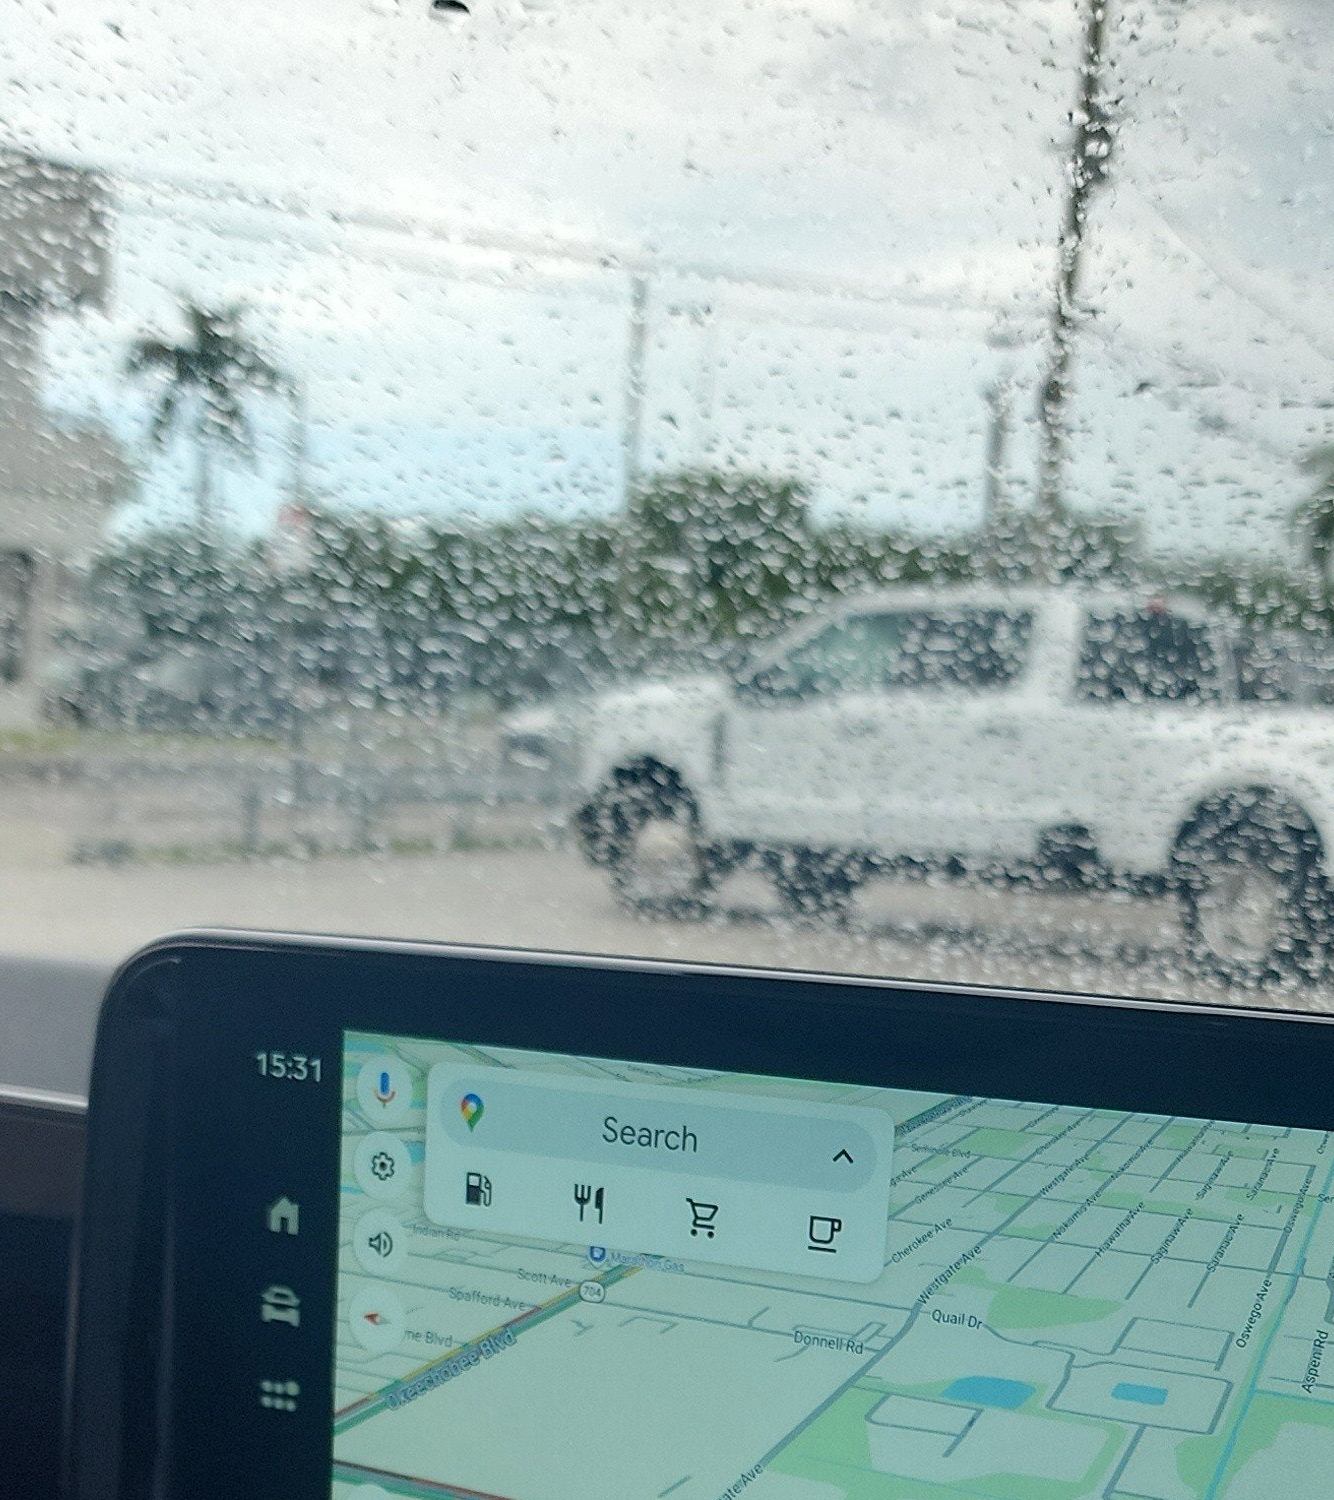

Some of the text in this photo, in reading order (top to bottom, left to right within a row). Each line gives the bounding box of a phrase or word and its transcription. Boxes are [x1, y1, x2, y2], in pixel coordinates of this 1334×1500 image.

[255, 1052, 323, 1083] 15:31
[602, 1115, 698, 1153] Search
[1220, 1150, 1234, 1168] Ave
[1267, 1147, 1280, 1165] Ave
[1040, 1154, 1090, 1196] Westgate Ave
[1086, 1191, 1103, 1207] Ave
[1283, 1177, 1313, 1235] Oswego Ave
[891, 1217, 952, 1264] Cherokee Ave
[1095, 1201, 1145, 1258] Hiawatha Ave
[1150, 1207, 1194, 1264] Saginaw Ave
[1206, 1212, 1245, 1273] Saranac Ave
[517, 1267, 572, 1288] Scott Ave
[663, 1259, 685, 1272] Gas
[917, 1245, 982, 1305] Westgate Ave
[449, 1287, 527, 1312] Spafford Ave
[582, 1284, 603, 1298] 704
[931, 1309, 983, 1330] Quail Dr
[1235, 1278, 1273, 1349] Oswego Ave
[425, 1331, 453, 1348] Blvd
[794, 1330, 864, 1356] Donnell Rd
[386, 1328, 518, 1412] Okeechobee Blvd
[1301, 1329, 1329, 1394] Aspen Rd
[740, 1462, 764, 1489] Ave
